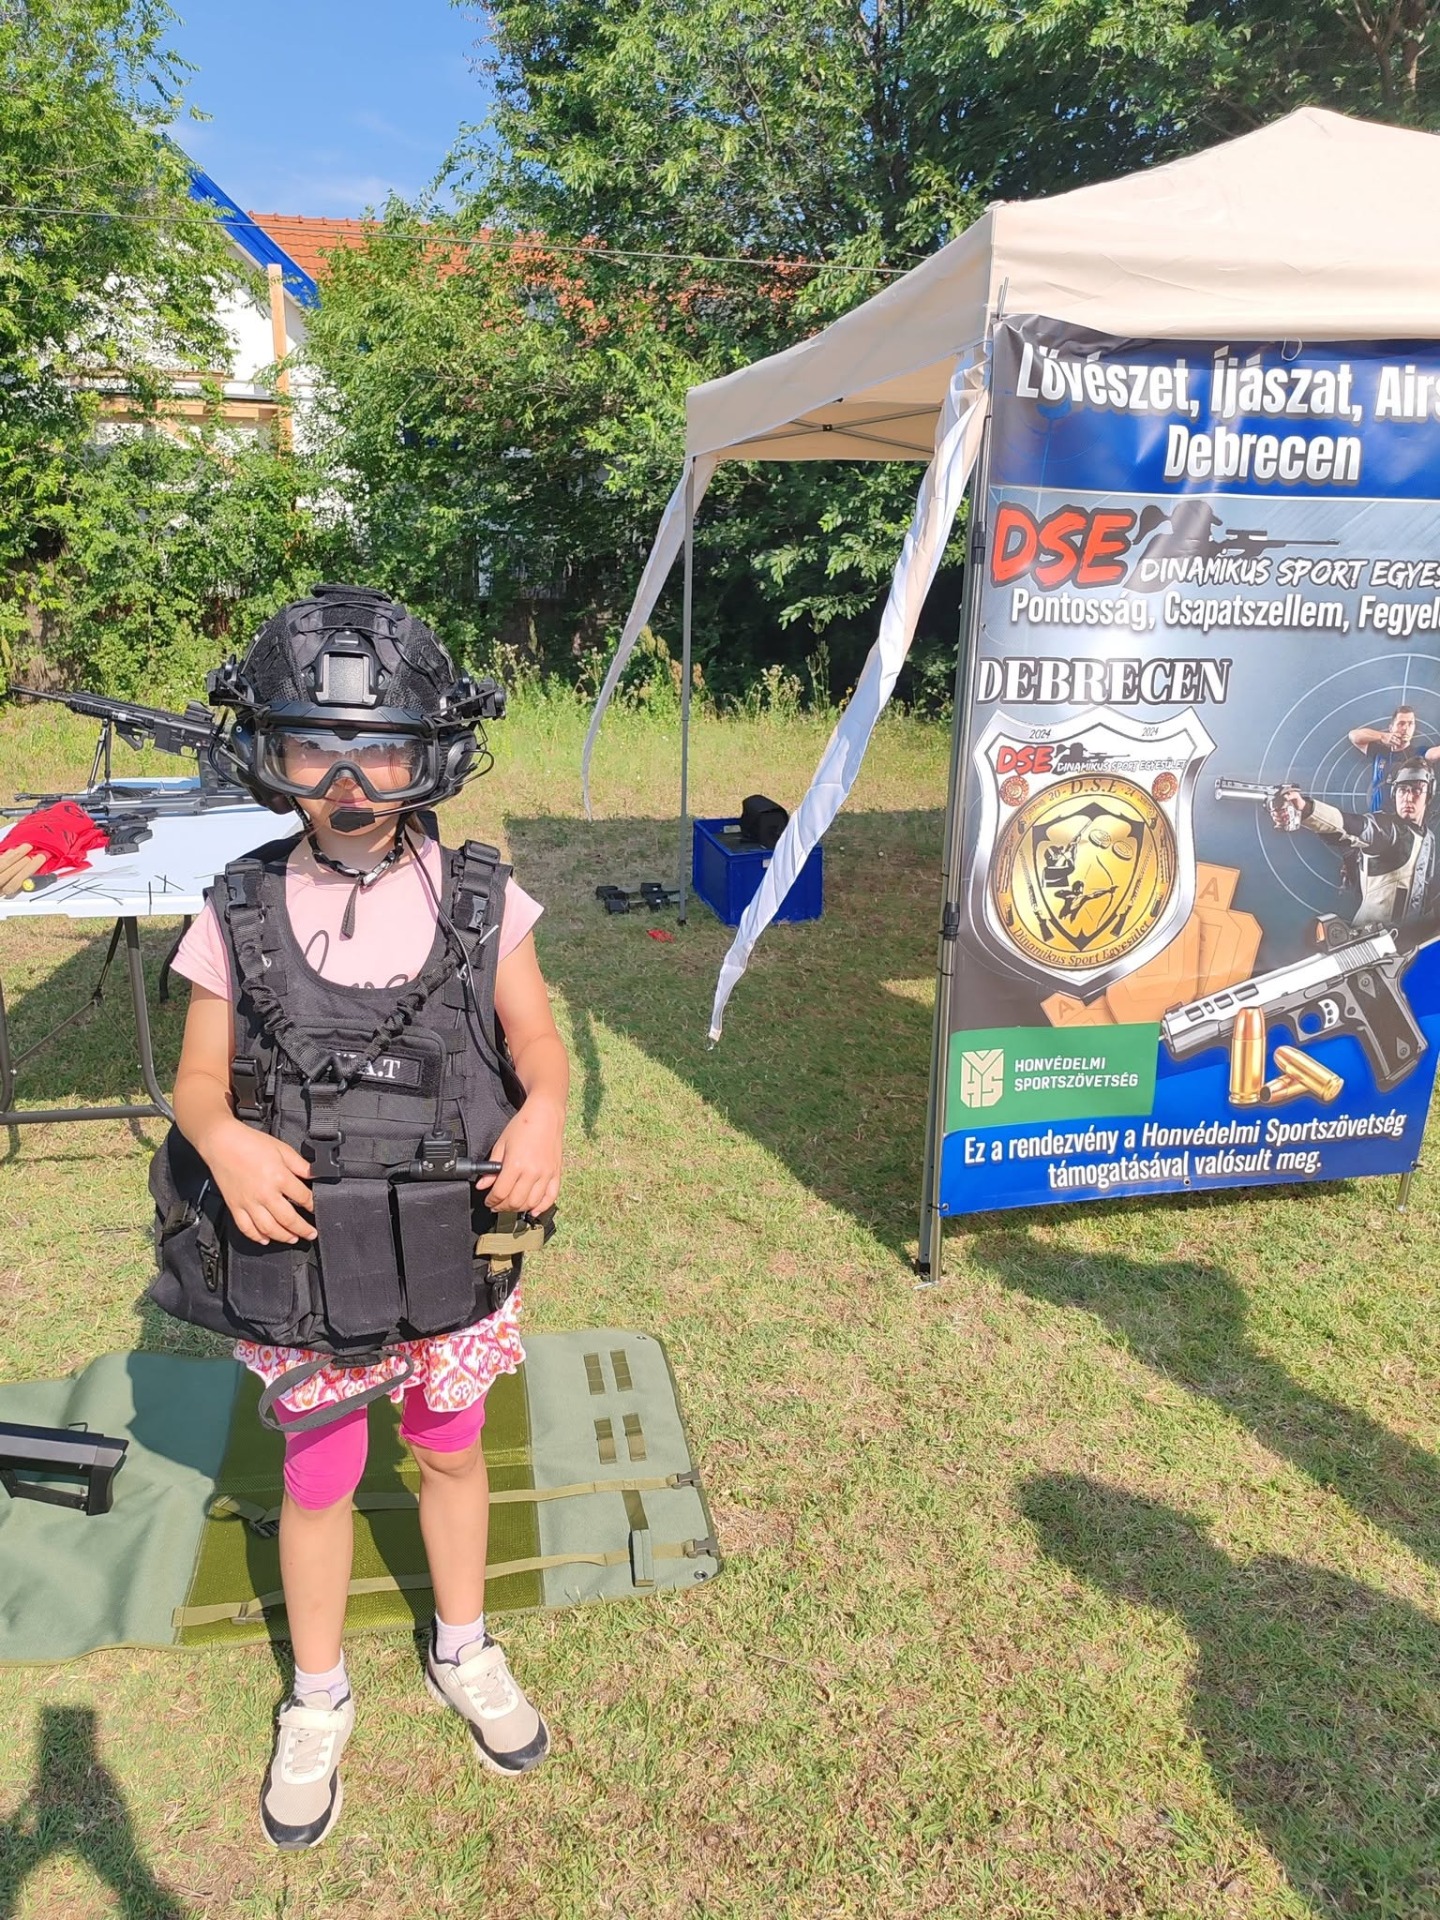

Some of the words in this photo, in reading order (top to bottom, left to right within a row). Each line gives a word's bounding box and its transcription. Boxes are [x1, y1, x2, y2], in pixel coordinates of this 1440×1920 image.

[1016, 343, 1200, 416] Lövészet,
[1164, 424, 1361, 481] Debrecen
[991, 503, 1136, 590] DSE
[1140, 549, 1270, 585] DINAMIKUS
[1276, 558, 1369, 590] SPORT
[1011, 588, 1156, 630] Pontosság,
[1164, 593, 1349, 634] Csapatszellem,
[1358, 595, 1440, 636] Fegyel
[976, 656, 1232, 706] DEBRECEN
[1029, 729, 1052, 739] 2024
[1141, 727, 1159, 737] 2024
[996, 745, 1055, 775] DSE
[1056, 759, 1109, 773] DINAMIKUS
[1110, 760, 1138, 773] SPORT
[1199, 876, 1219, 902] A
[1013, 927, 1066, 965] Dinamikus
[1068, 953, 1100, 967] Sport
[1058, 999, 1074, 1020] A
[1014, 1055, 1106, 1073] HONVÉDELMI
[1014, 1072, 1139, 1092] SPORTSZÖVETSÉG
[964, 1138, 985, 1163] Ez
[991, 1143, 1003, 1161] a
[1008, 1124, 1118, 1161] rendezvény
[1124, 1131, 1136, 1150] a
[1142, 1121, 1260, 1149] Honvédelmi
[1265, 1109, 1407, 1144] Sportszövetség
[1048, 1151, 1190, 1188] támogatásával
[1195, 1149, 1272, 1175] valósult
[1276, 1150, 1322, 1174] meg.
